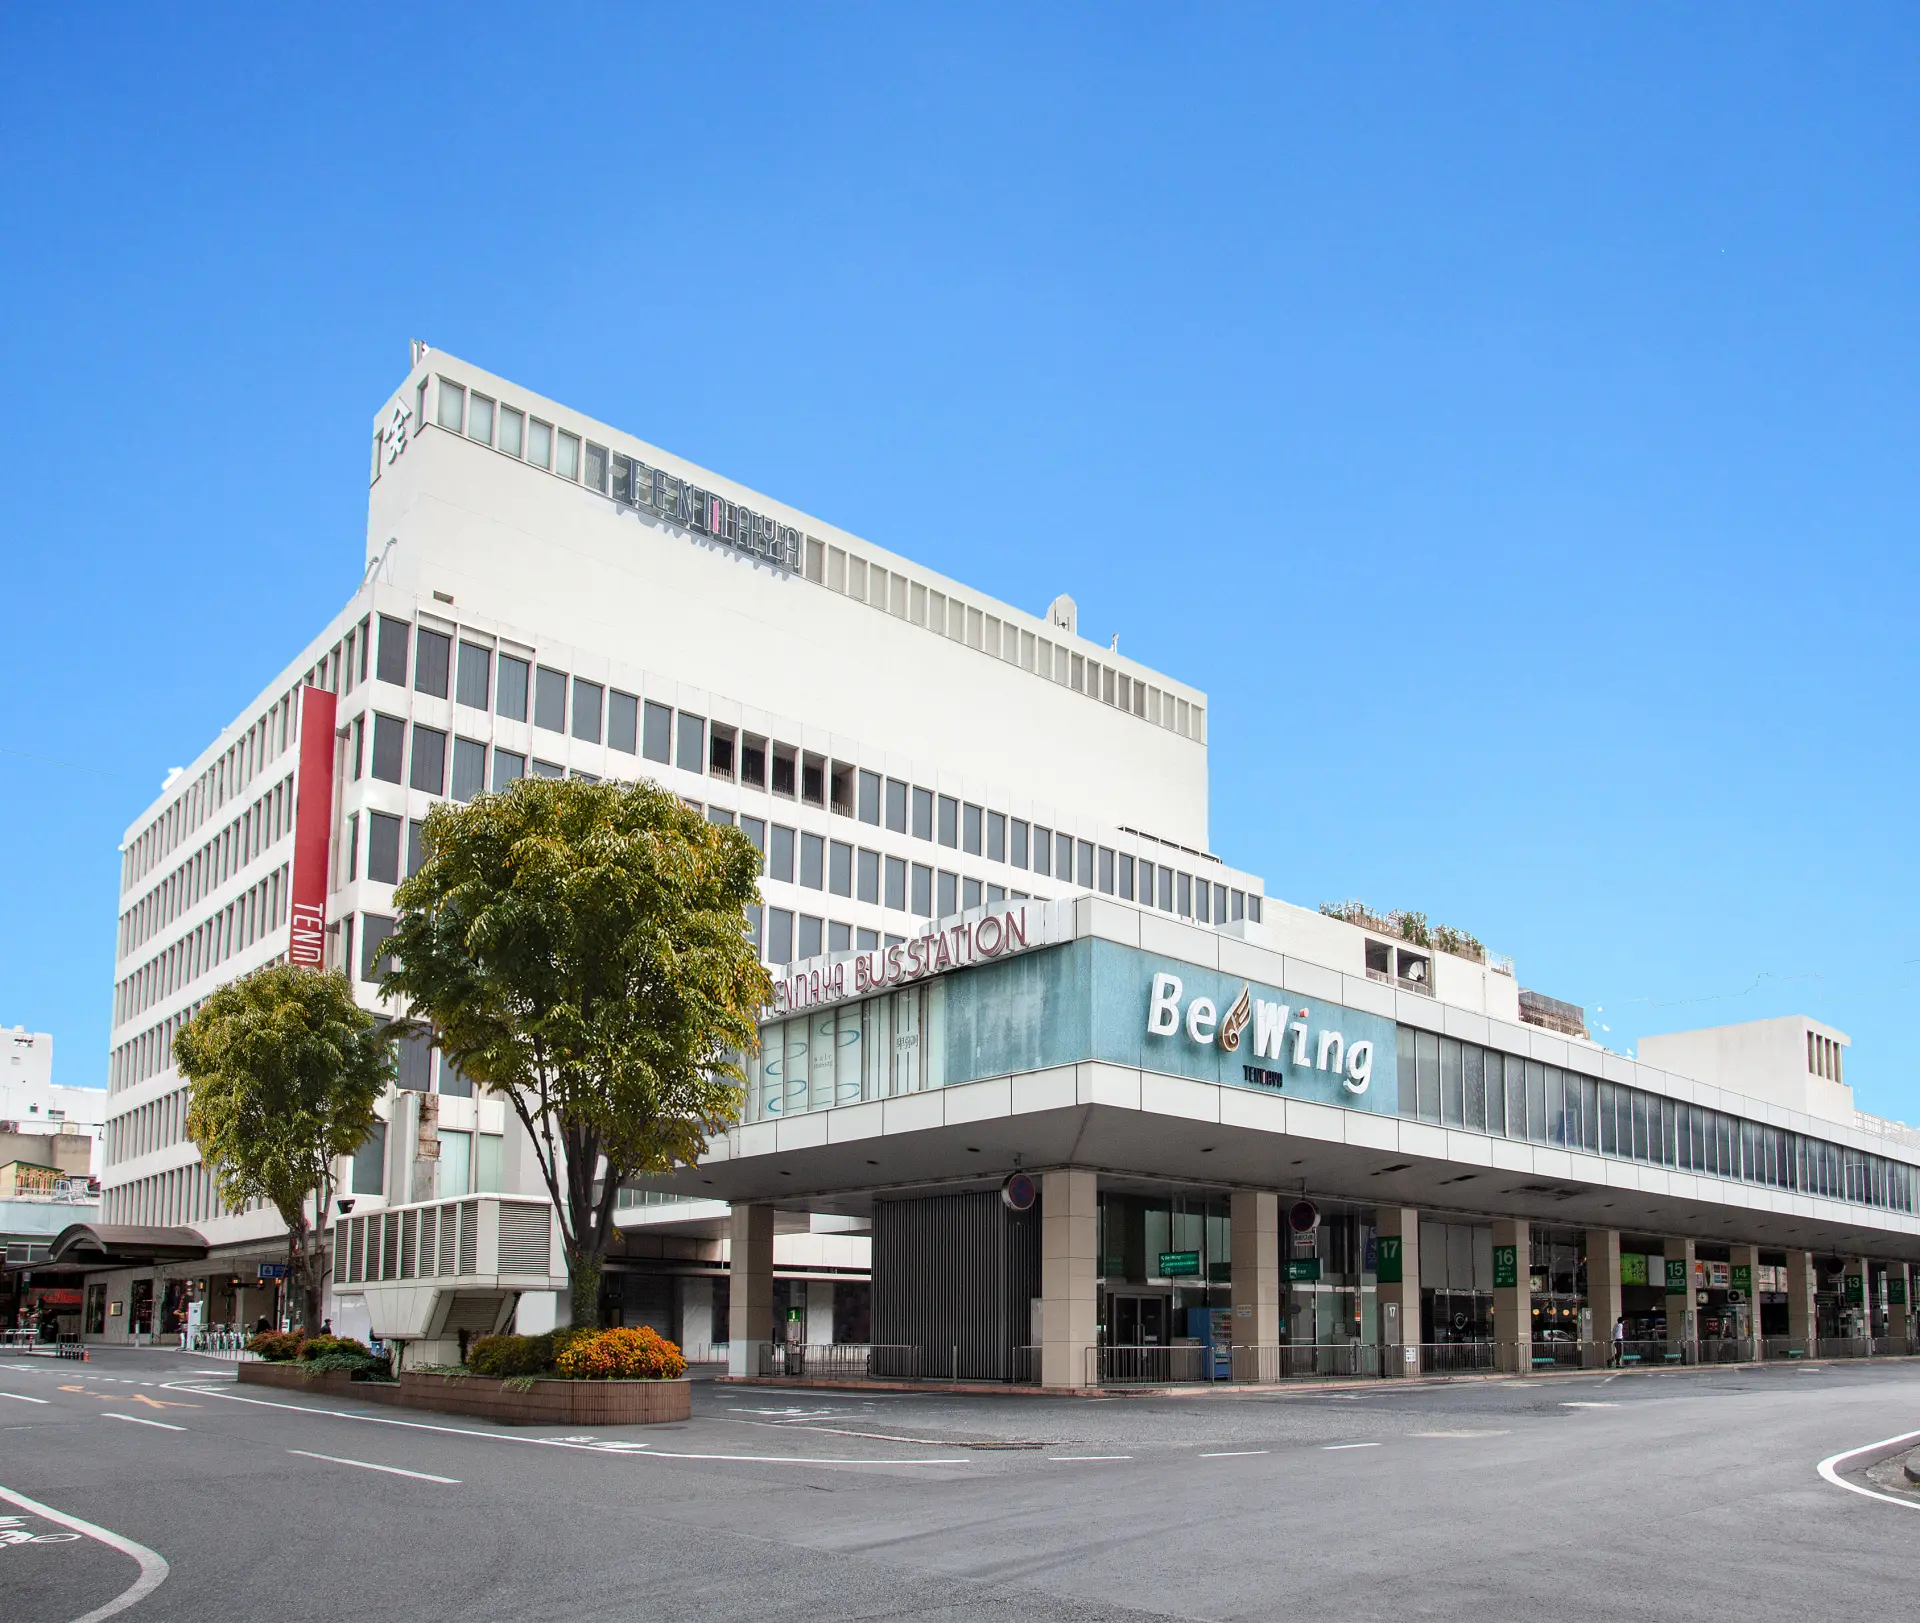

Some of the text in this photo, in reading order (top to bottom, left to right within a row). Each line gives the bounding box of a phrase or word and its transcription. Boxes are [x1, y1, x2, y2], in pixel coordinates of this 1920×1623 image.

[622, 454, 801, 568] TENMAYA
[765, 962, 844, 1017] ENMAYA
[1147, 971, 1374, 1094] Be Wing
[1381, 1240, 1399, 1259] 17
[1495, 1249, 1514, 1266] 16
[1667, 1262, 1684, 1276] 15
[1735, 1267, 1748, 1278] 14
[1847, 1277, 1860, 1289] 13
[1890, 1280, 1903, 1291] 12
[1389, 1306, 1396, 1317] 17
